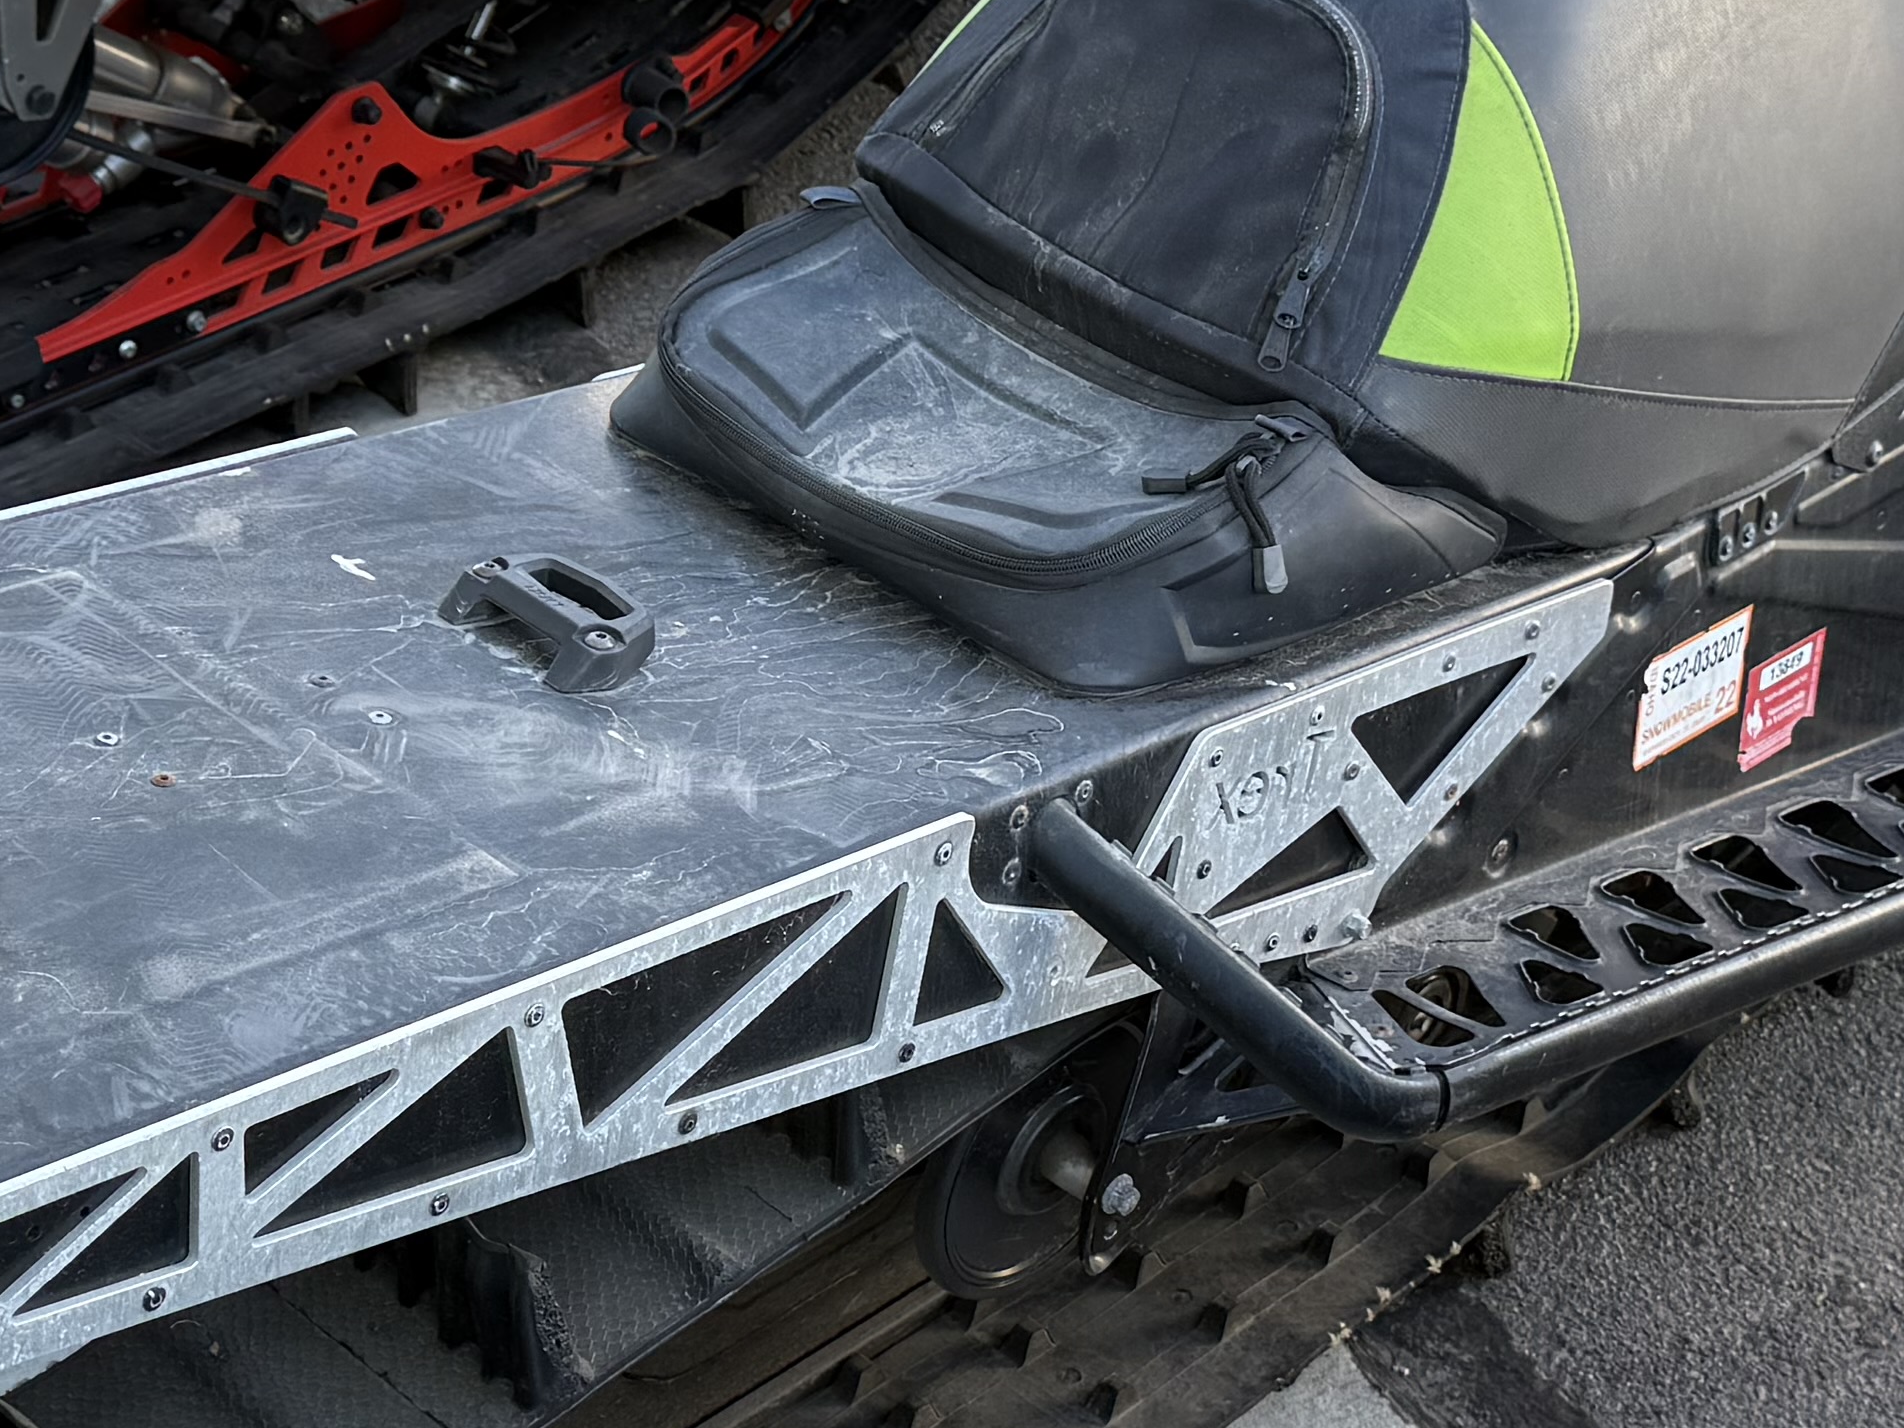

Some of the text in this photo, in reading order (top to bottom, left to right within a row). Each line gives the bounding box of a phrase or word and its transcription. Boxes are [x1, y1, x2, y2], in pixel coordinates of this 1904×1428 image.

[1661, 627, 1745, 695] S22-033207
[1642, 693, 1713, 745] SNOWMOBILE
[1714, 679, 1738, 715] 22
